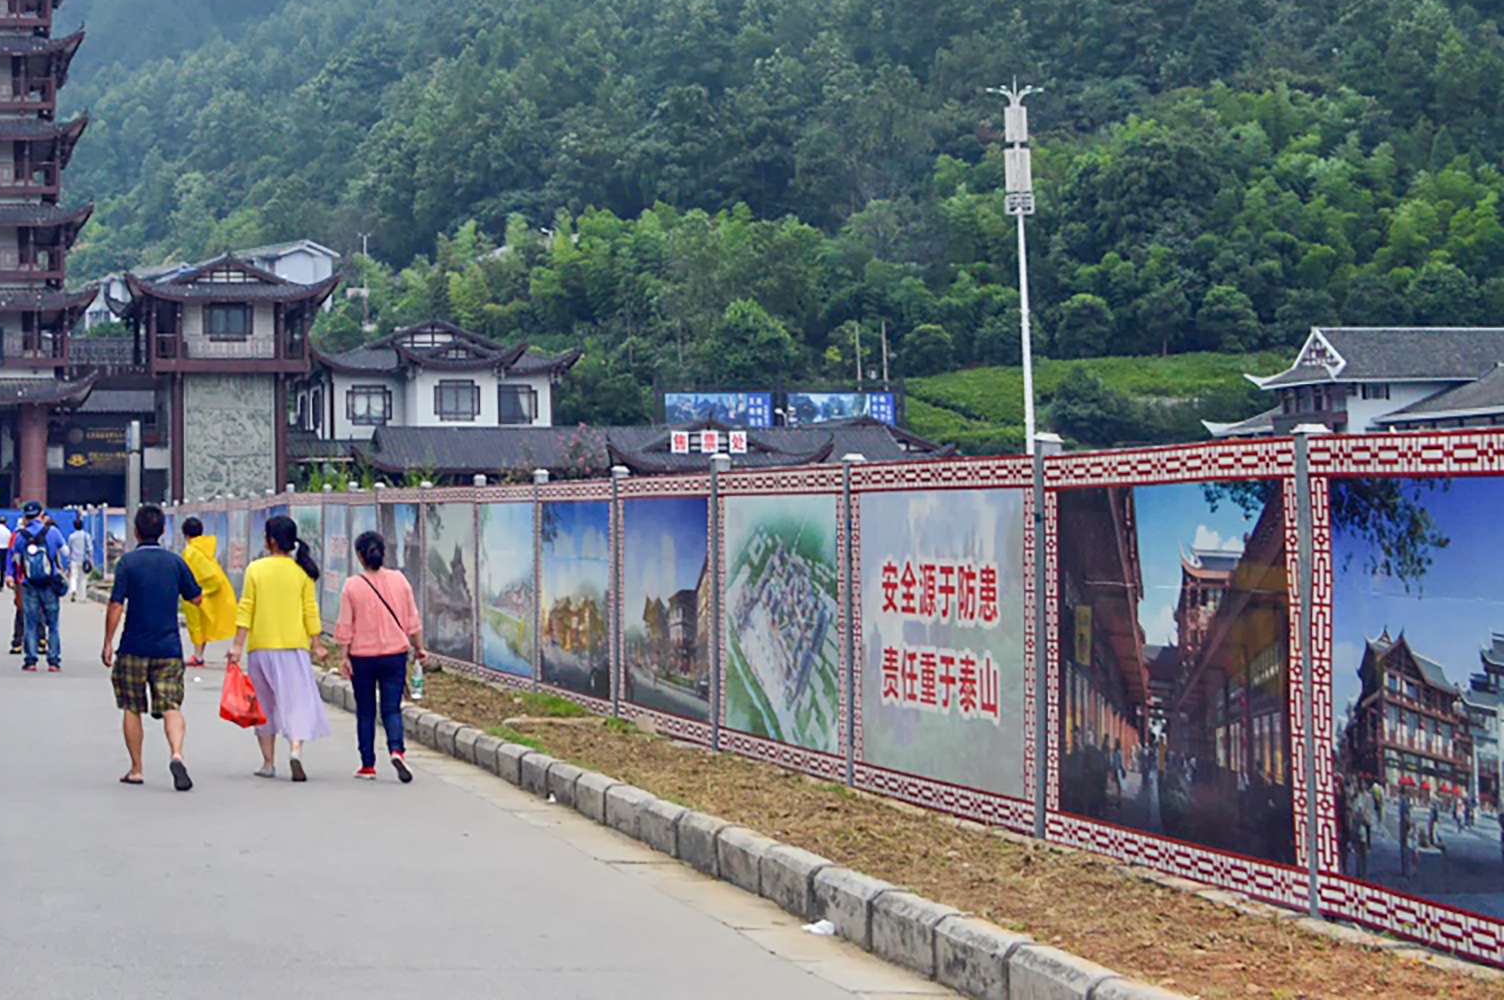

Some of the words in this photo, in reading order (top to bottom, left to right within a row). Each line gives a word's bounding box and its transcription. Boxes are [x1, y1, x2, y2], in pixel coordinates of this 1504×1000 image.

[673, 432, 744, 450] 售票处
[882, 561, 998, 622] 安全源于防患
[882, 646, 998, 718] 责任重于泰山
